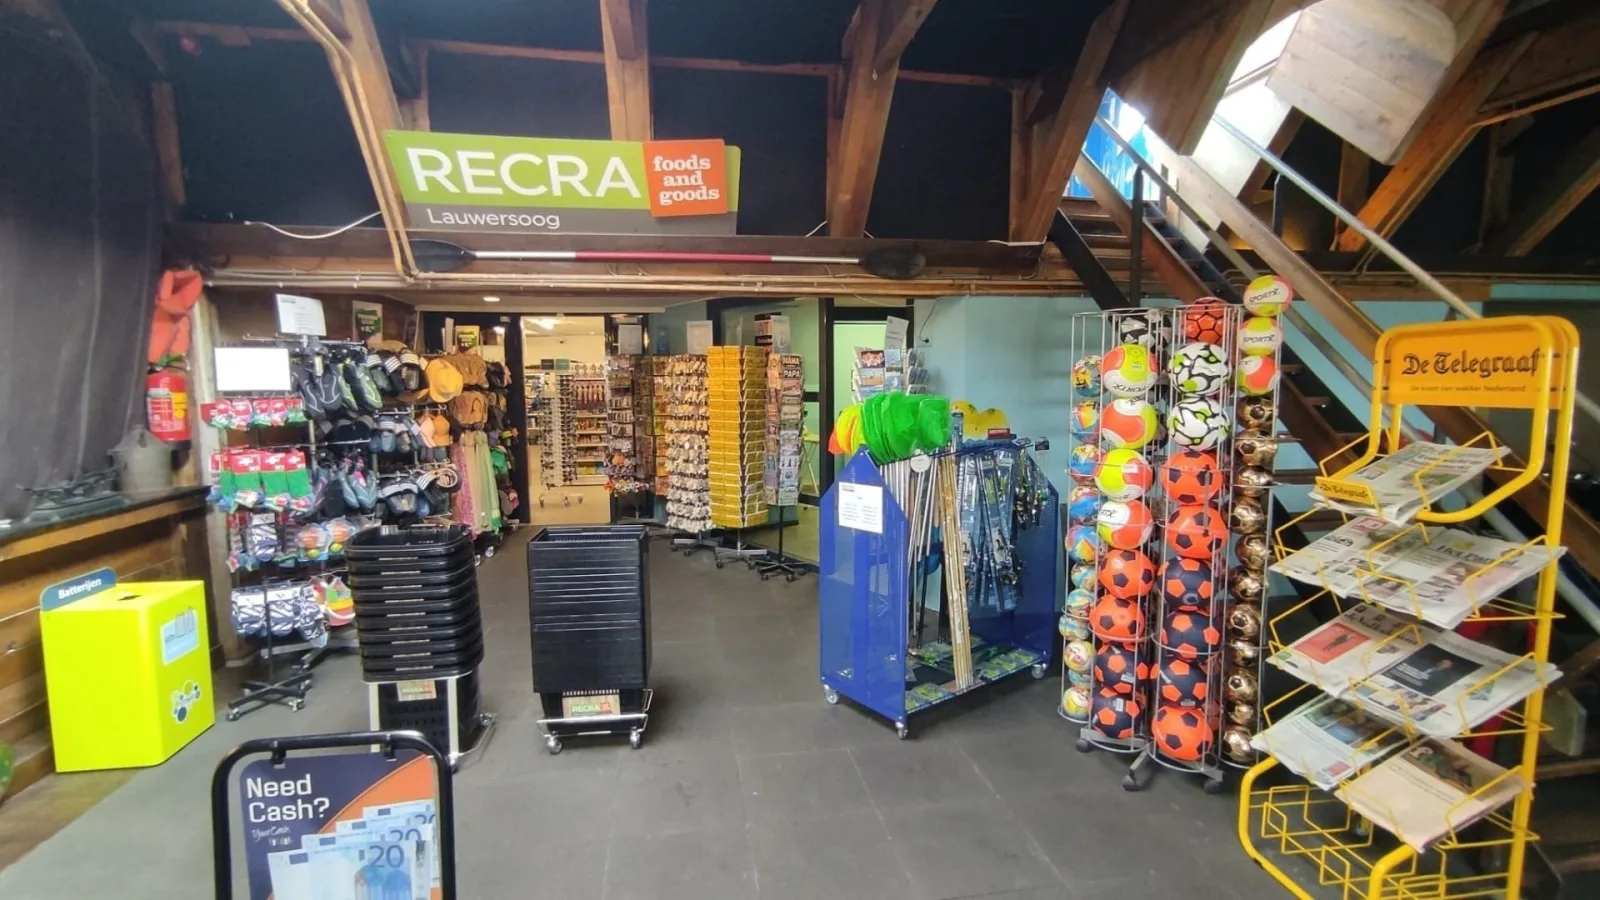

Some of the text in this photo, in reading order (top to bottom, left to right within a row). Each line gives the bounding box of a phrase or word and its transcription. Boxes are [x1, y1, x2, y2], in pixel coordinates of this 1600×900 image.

[406, 147, 642, 198] RECRA
[653, 154, 711, 172] foods
[663, 170, 704, 187] and
[658, 185, 720, 205] goods
[426, 208, 561, 229] Lauwersoog
[1401, 347, 1541, 379] De Telegraaf
[58, 578, 102, 600] Batterijen
[246, 773, 312, 799] Need
[249, 797, 330, 823] Cash?
[369, 844, 405, 869] 20
